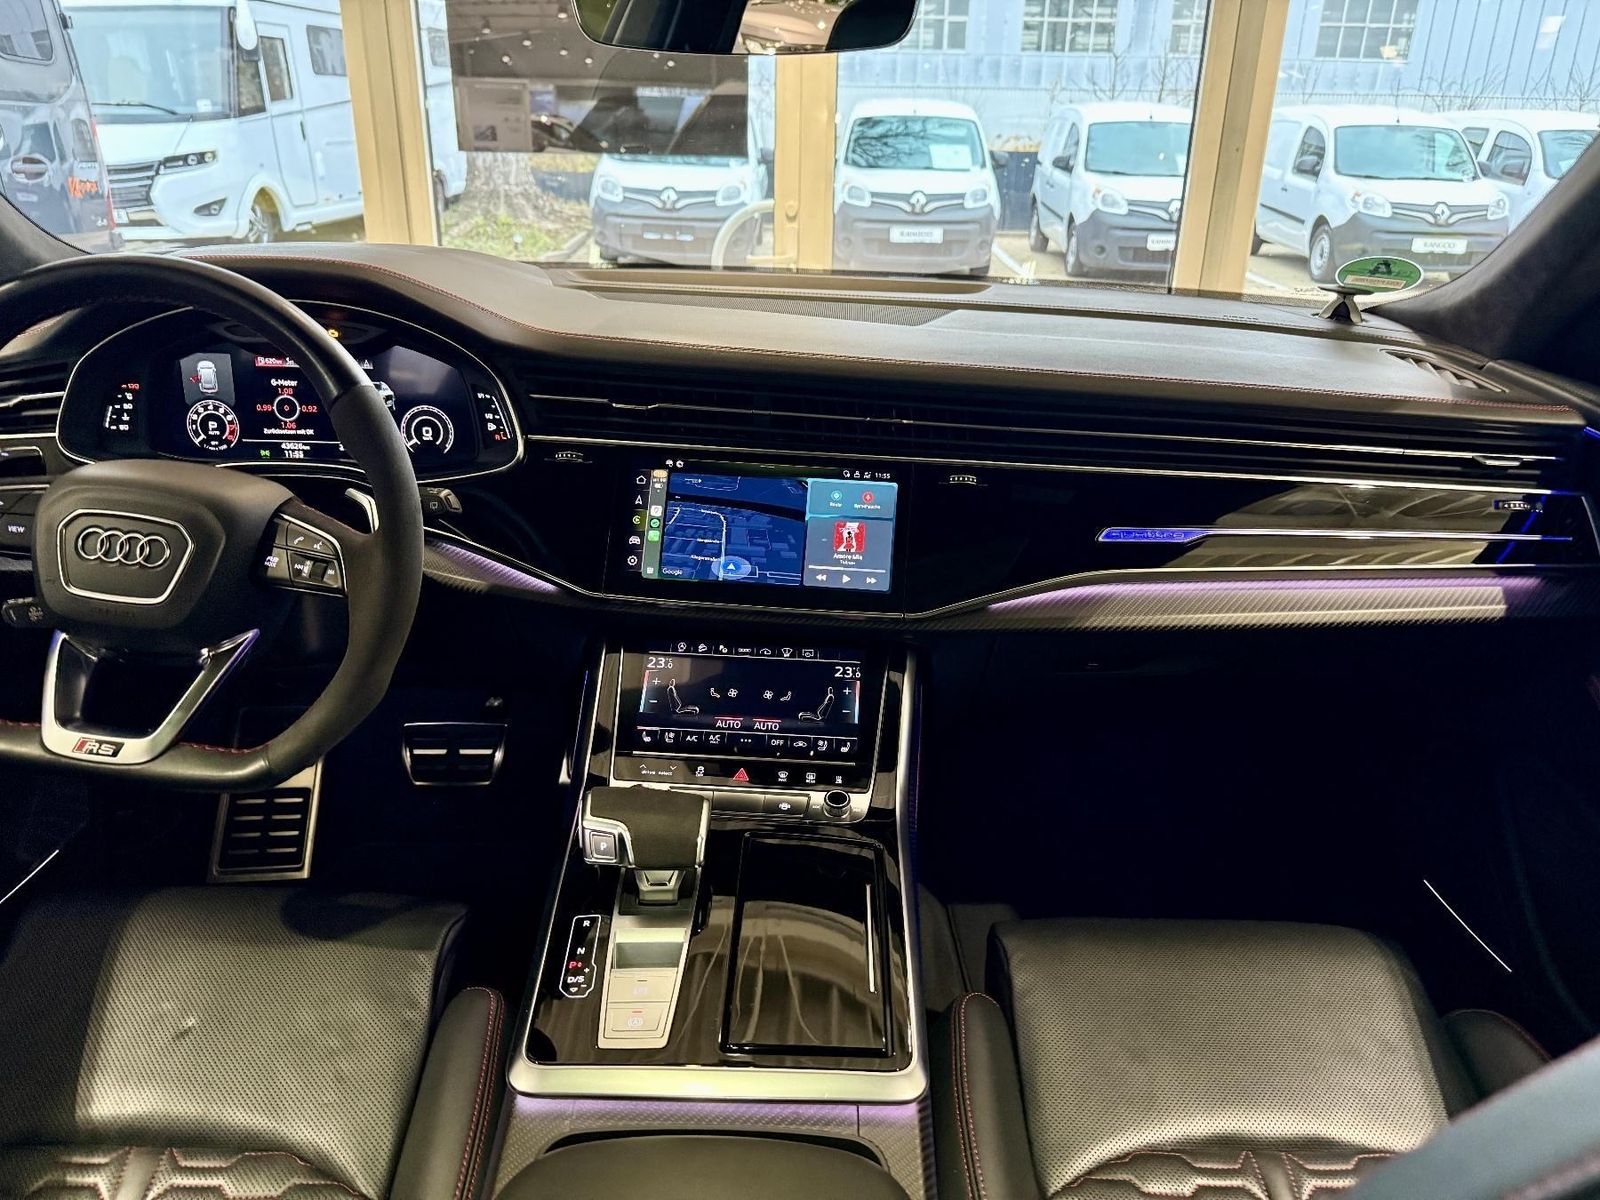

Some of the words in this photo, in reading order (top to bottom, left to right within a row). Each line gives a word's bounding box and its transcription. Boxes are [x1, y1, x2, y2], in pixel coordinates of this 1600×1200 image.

[271, 378, 298, 387] G-Meter
[278, 387, 294, 395] 1.08
[256, 404, 272, 412] 0.99
[301, 404, 318, 413] 0.92
[208, 420, 218, 431] P
[281, 421, 297, 429] 1.06
[284, 450, 304, 458] 11:55
[7, 525, 25, 533] VIEW
[662, 568, 683, 576] Google
[715, 720, 742, 729] AUTO
[753, 722, 780, 731] AUTO
[685, 735, 699, 743] A/C
[708, 734, 721, 742] A/C
[770, 738, 785, 747] OFF
[600, 842, 607, 850] P
[582, 919, 591, 927] R
[576, 947, 586, 955] N
[567, 975, 585, 983] D/S
